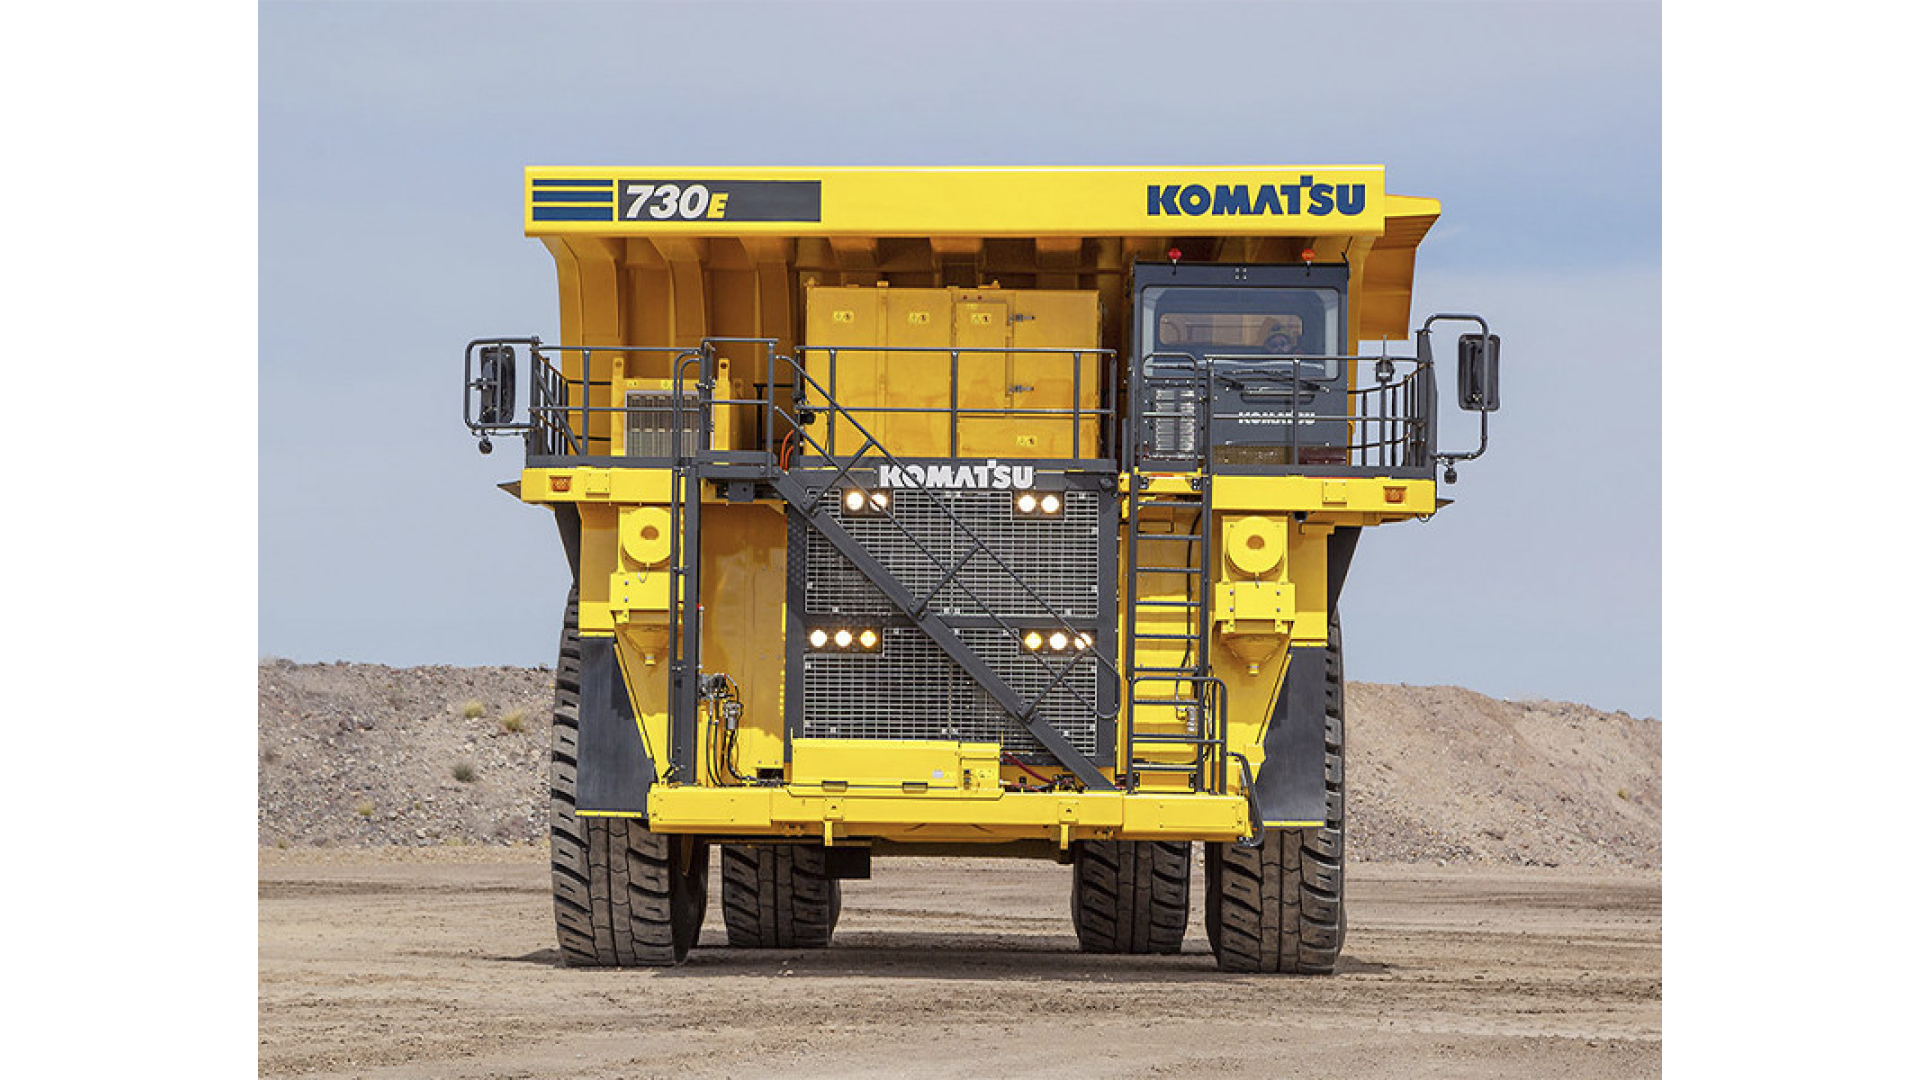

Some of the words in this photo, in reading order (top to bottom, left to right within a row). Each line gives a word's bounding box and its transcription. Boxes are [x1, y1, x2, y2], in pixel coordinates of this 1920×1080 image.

[626, 184, 729, 219] 730E
[1147, 175, 1366, 216] KOMATSU
[880, 459, 1034, 488] KOMATSU
